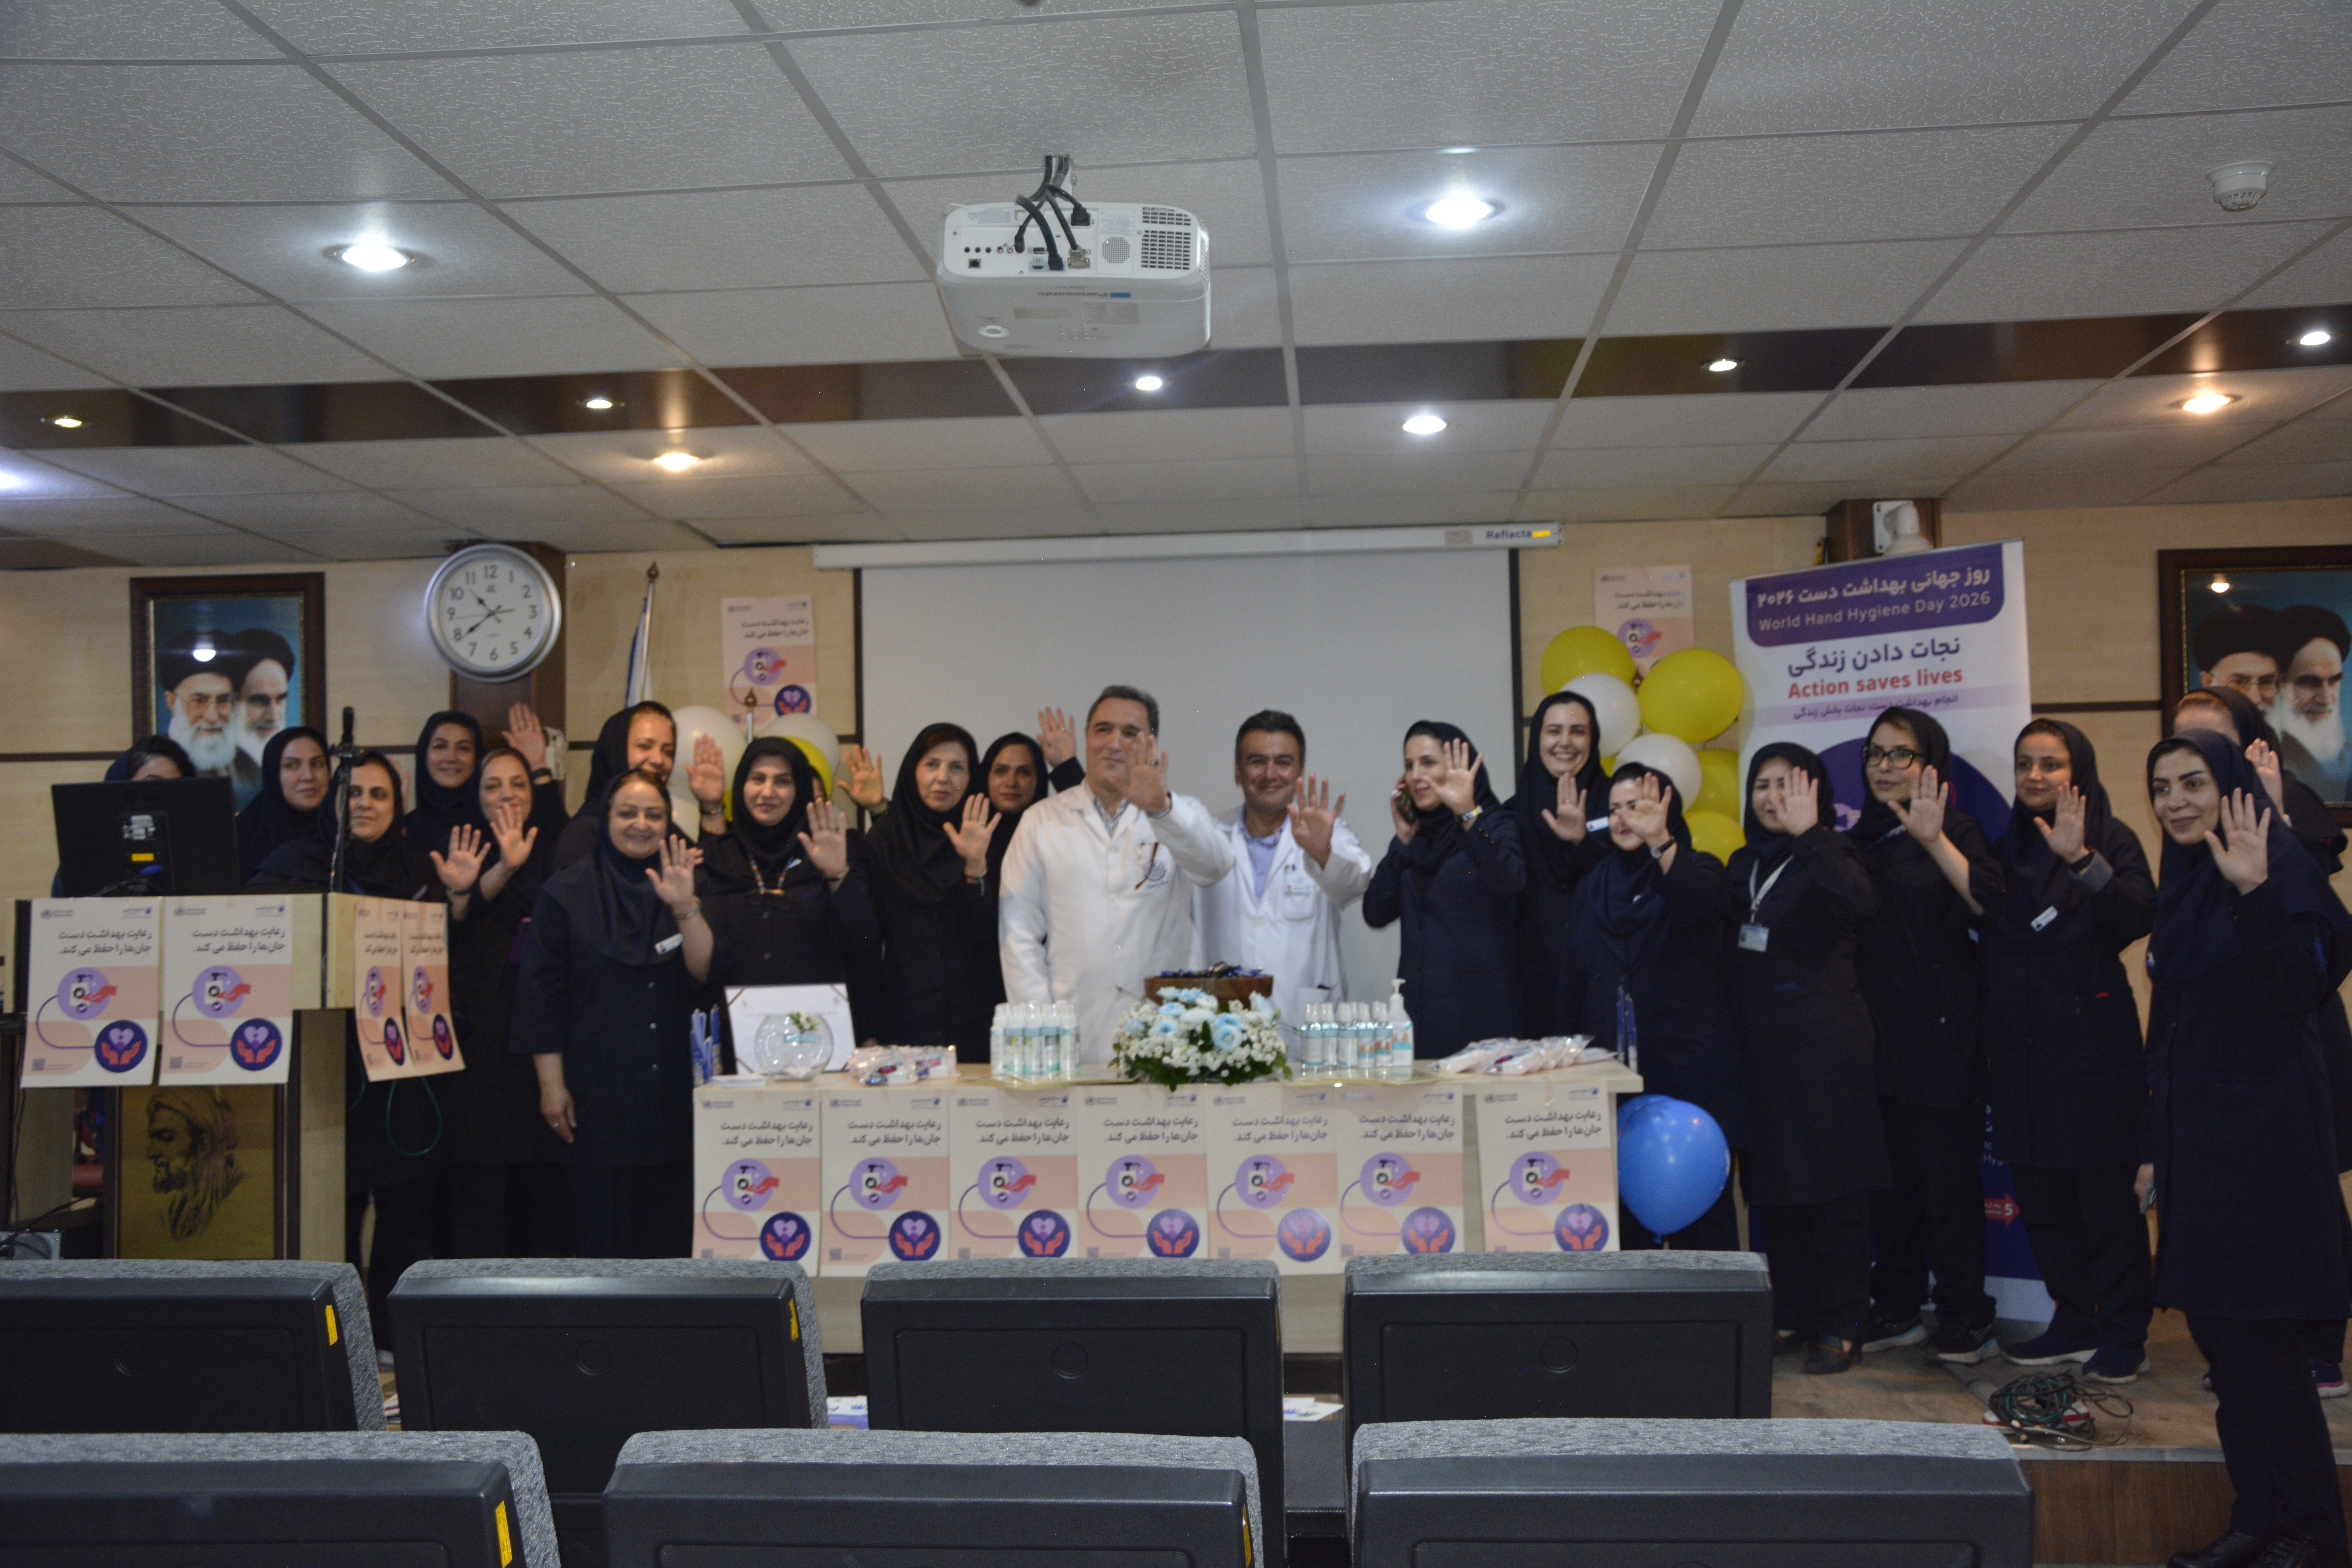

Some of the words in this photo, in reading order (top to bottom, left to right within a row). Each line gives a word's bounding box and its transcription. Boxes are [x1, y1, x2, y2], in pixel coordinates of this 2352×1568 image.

[484, 565, 497, 578] 12
[510, 571, 514, 583] 1
[1964, 567, 1990, 586] روز
[465, 571, 475, 584] 11
[1911, 570, 1960, 592] جهانی
[523, 585, 530, 598] 2
[1842, 577, 1907, 597] بهداشت
[452, 587, 465, 600] 10
[1798, 586, 1838, 603] دست
[447, 607, 455, 621] 9
[529, 605, 537, 619] 3
[1759, 615, 1800, 631] World
[1805, 610, 1842, 626] Hand
[1847, 604, 1911, 623] Hygiene
[1915, 599, 1945, 613] Day
[1949, 590, 1991, 608] 2026
[454, 628, 462, 641] 8
[524, 627, 532, 639] 4
[469, 642, 477, 656] 7
[510, 641, 519, 655] 5
[1911, 637, 1960, 661] نجات
[490, 648, 499, 661] 6
[1853, 643, 1903, 671] دادن
[1788, 647, 1846, 677] زندگی
[1788, 679, 1849, 699] Action
[1857, 675, 1911, 692] saves
[1917, 668, 1963, 686] lives
[87, 929, 125, 939] بهداشت
[127, 927, 152, 940] رعایت
[220, 927, 258, 937] بهداشت
[261, 926, 285, 938] رعایت
[78, 947, 91, 955] می
[94, 944, 114, 952] حفظ
[116, 944, 123, 955] را
[212, 945, 225, 954] می
[227, 942, 247, 951] حفظ
[249, 942, 256, 953] را
[1261, 1116, 1299, 1126] بهداشت
[1302, 1115, 1328, 1126] رعایت
[1387, 1114, 1427, 1125] بهداشت
[1429, 1114, 1454, 1126] رعایت
[1534, 1112, 1573, 1122] بهداشت
[1575, 1110, 1601, 1121] رعایت
[748, 1121, 786, 1131] بهداشت
[788, 1121, 813, 1132] رعایت
[875, 1120, 914, 1130] بهداشت
[916, 1119, 940, 1131] رعایت
[1004, 1118, 1042, 1129] بهداشت
[1044, 1118, 1069, 1129] رعایت
[1132, 1117, 1171, 1127] بهداشت
[1173, 1117, 1198, 1128] رعایت
[1011, 1133, 1031, 1142] حفظ
[1140, 1132, 1160, 1140] حفظ
[1162, 1131, 1169, 1143] را
[1269, 1131, 1289, 1140] حفظ
[1291, 1131, 1298, 1142] را
[1381, 1132, 1393, 1141] می
[1396, 1129, 1416, 1138] حفظ
[1418, 1129, 1425, 1141] را
[1527, 1131, 1539, 1140] می
[1542, 1128, 1562, 1136] حفظ
[1565, 1127, 1572, 1138] را
[755, 1136, 775, 1144] حفظ
[778, 1136, 784, 1147] را
[868, 1138, 880, 1146] می
[883, 1134, 903, 1143] حفظ
[906, 1134, 912, 1145] را
[996, 1136, 1009, 1145] می
[1034, 1133, 1040, 1145] را
[1125, 1135, 1136, 1144] می
[1254, 1134, 1266, 1143] می
